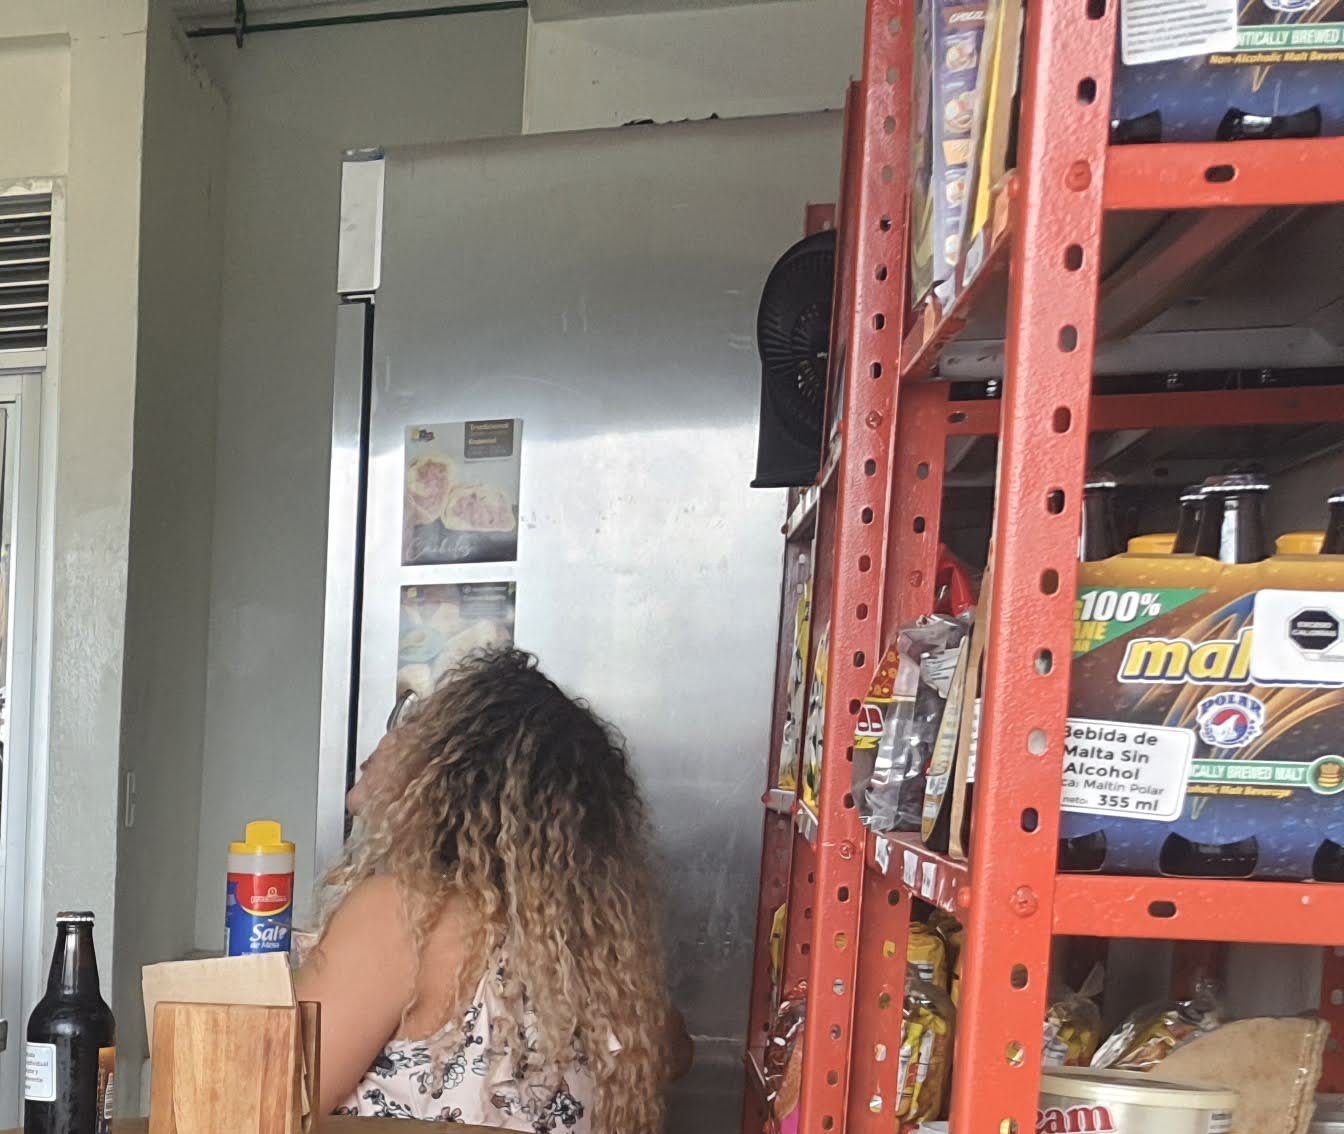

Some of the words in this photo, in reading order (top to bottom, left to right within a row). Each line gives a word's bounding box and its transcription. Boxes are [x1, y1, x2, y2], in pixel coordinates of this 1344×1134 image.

[1080, 589, 1162, 622] 100%
[1073, 622, 1108, 639] ANE
[1199, 693, 1263, 717] POLAR
[1133, 730, 1158, 746] de
[1064, 745, 1114, 761] Malta
[1120, 749, 1150, 764] Sin
[1064, 762, 1141, 781] Alcohol
[1275, 766, 1305, 781] MALT
[1097, 795, 1129, 808] 355
[1135, 799, 1159, 811] ml
[248, 923, 279, 942] Sal
